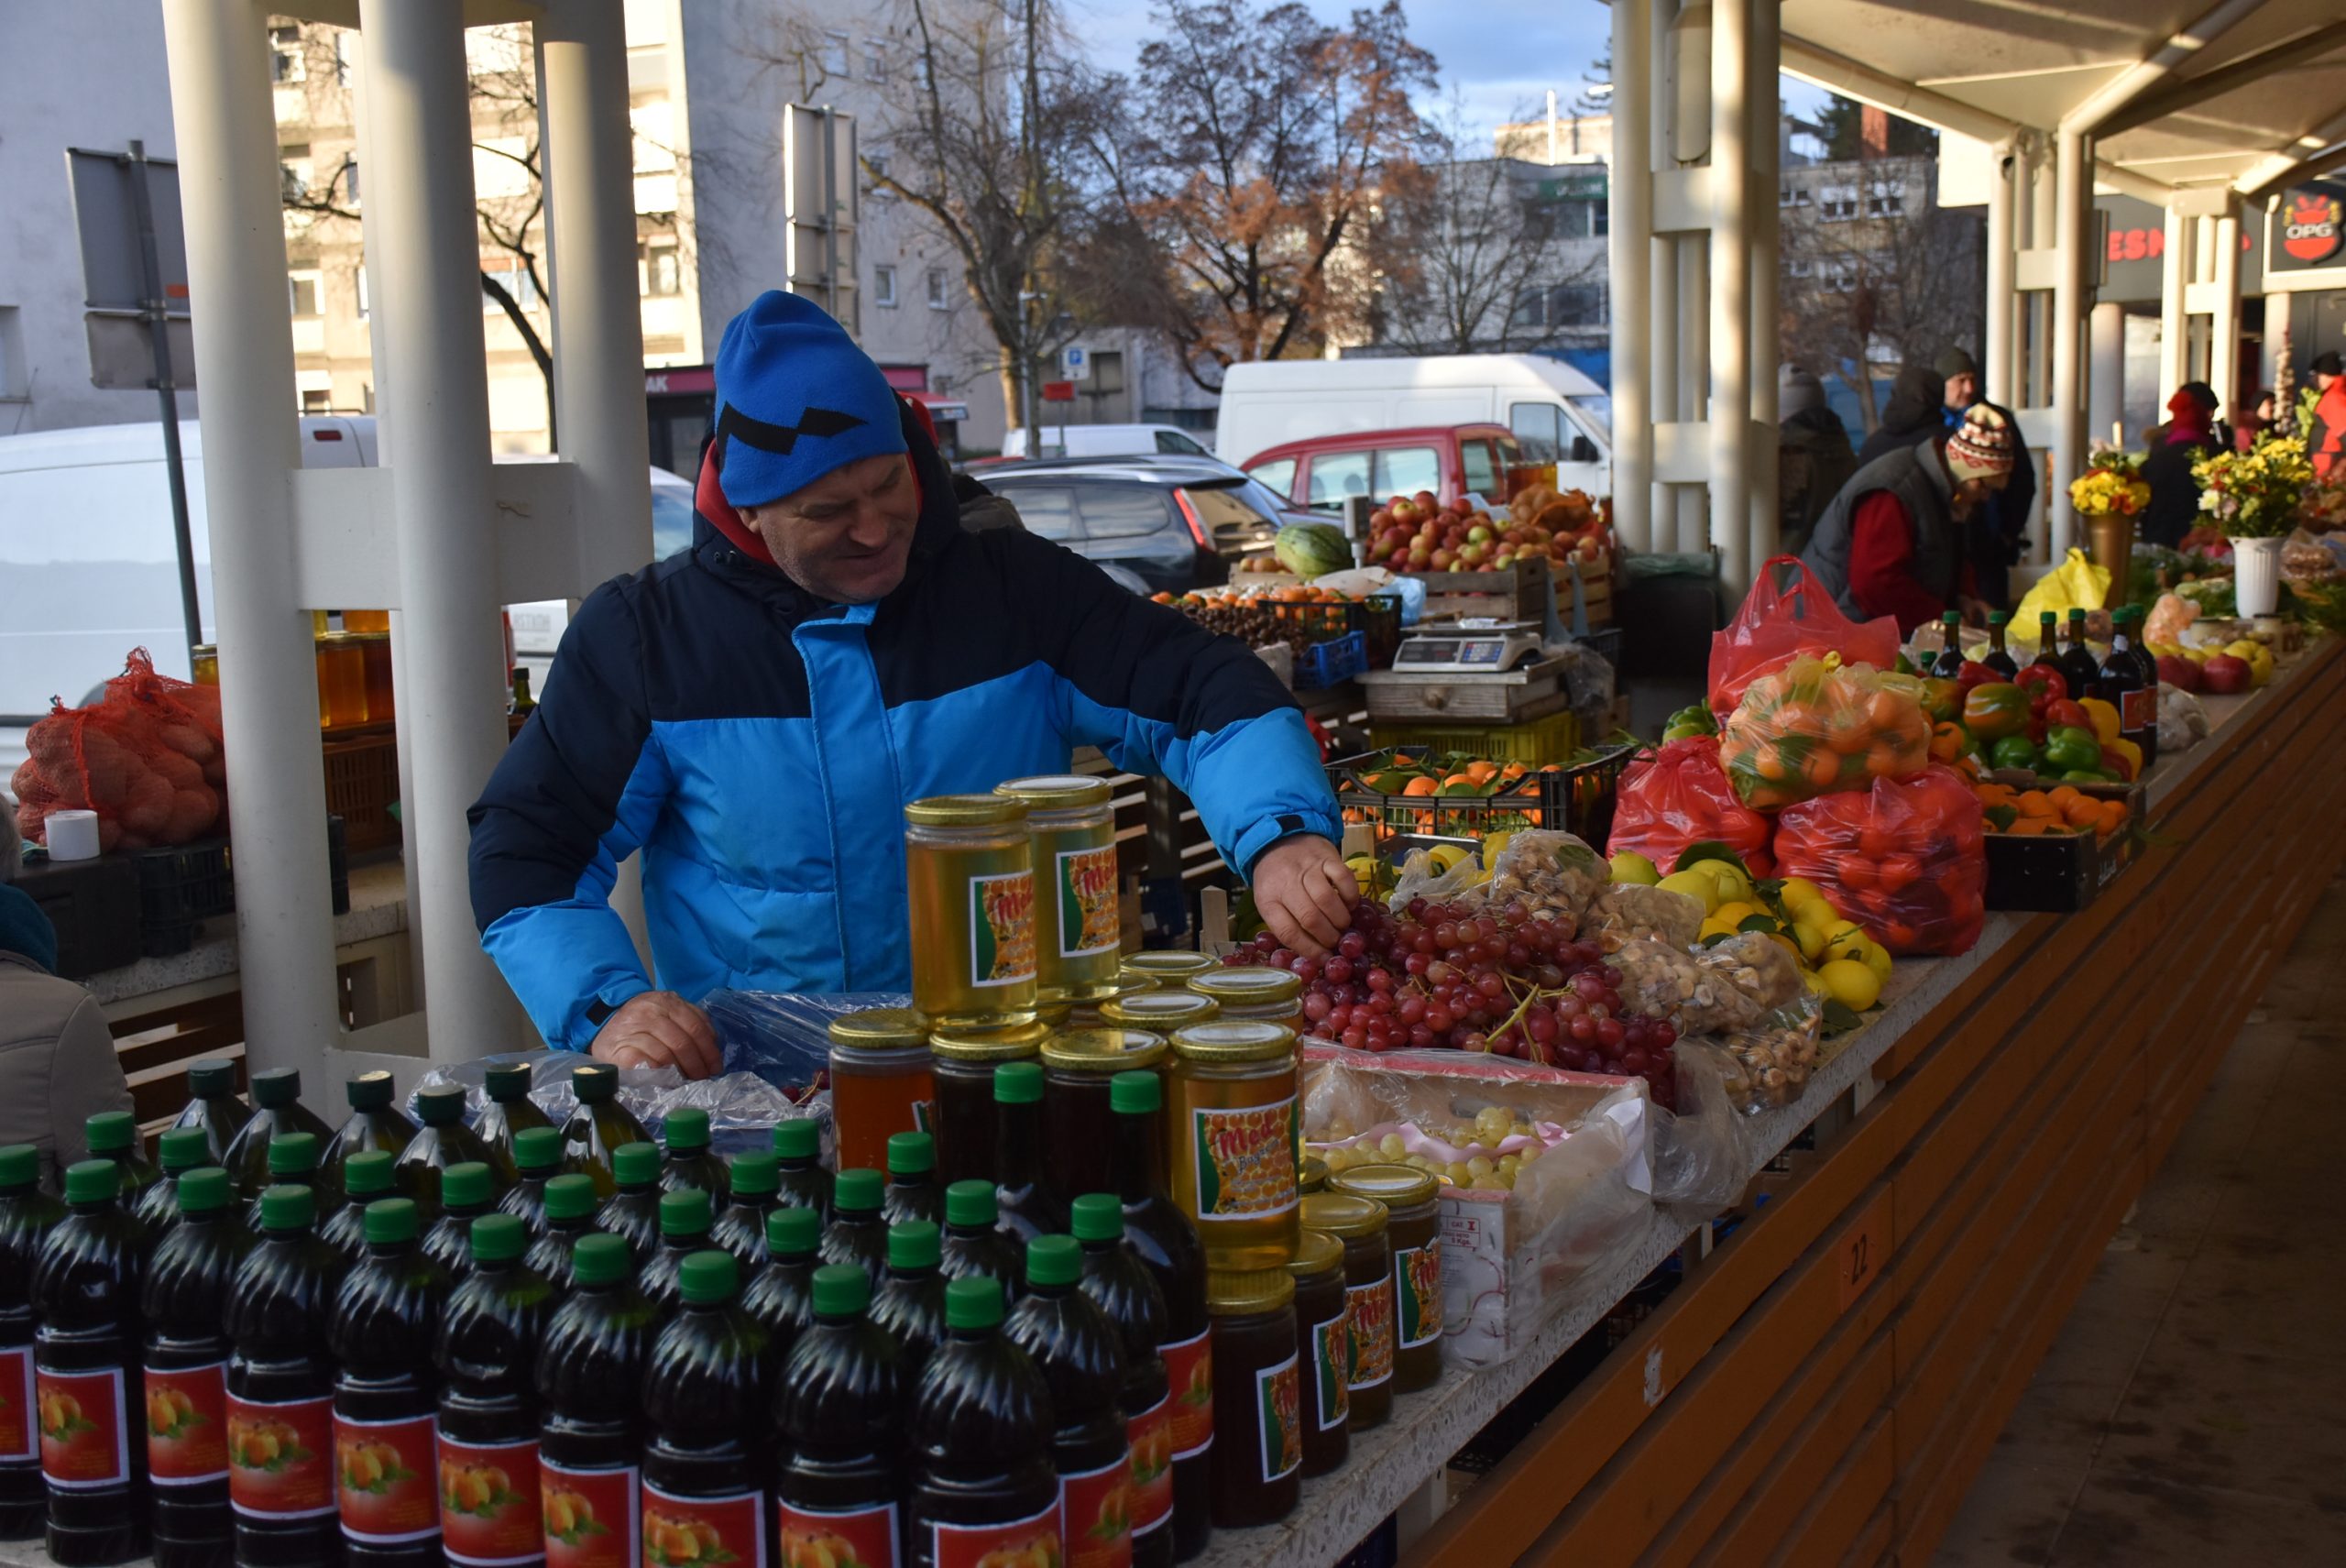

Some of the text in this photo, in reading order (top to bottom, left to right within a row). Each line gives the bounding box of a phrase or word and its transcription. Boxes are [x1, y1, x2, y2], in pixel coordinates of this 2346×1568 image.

[2286, 223, 2332, 239] OPG
[1219, 1121, 1273, 1158] Med
[1851, 1234, 1868, 1286] 22
